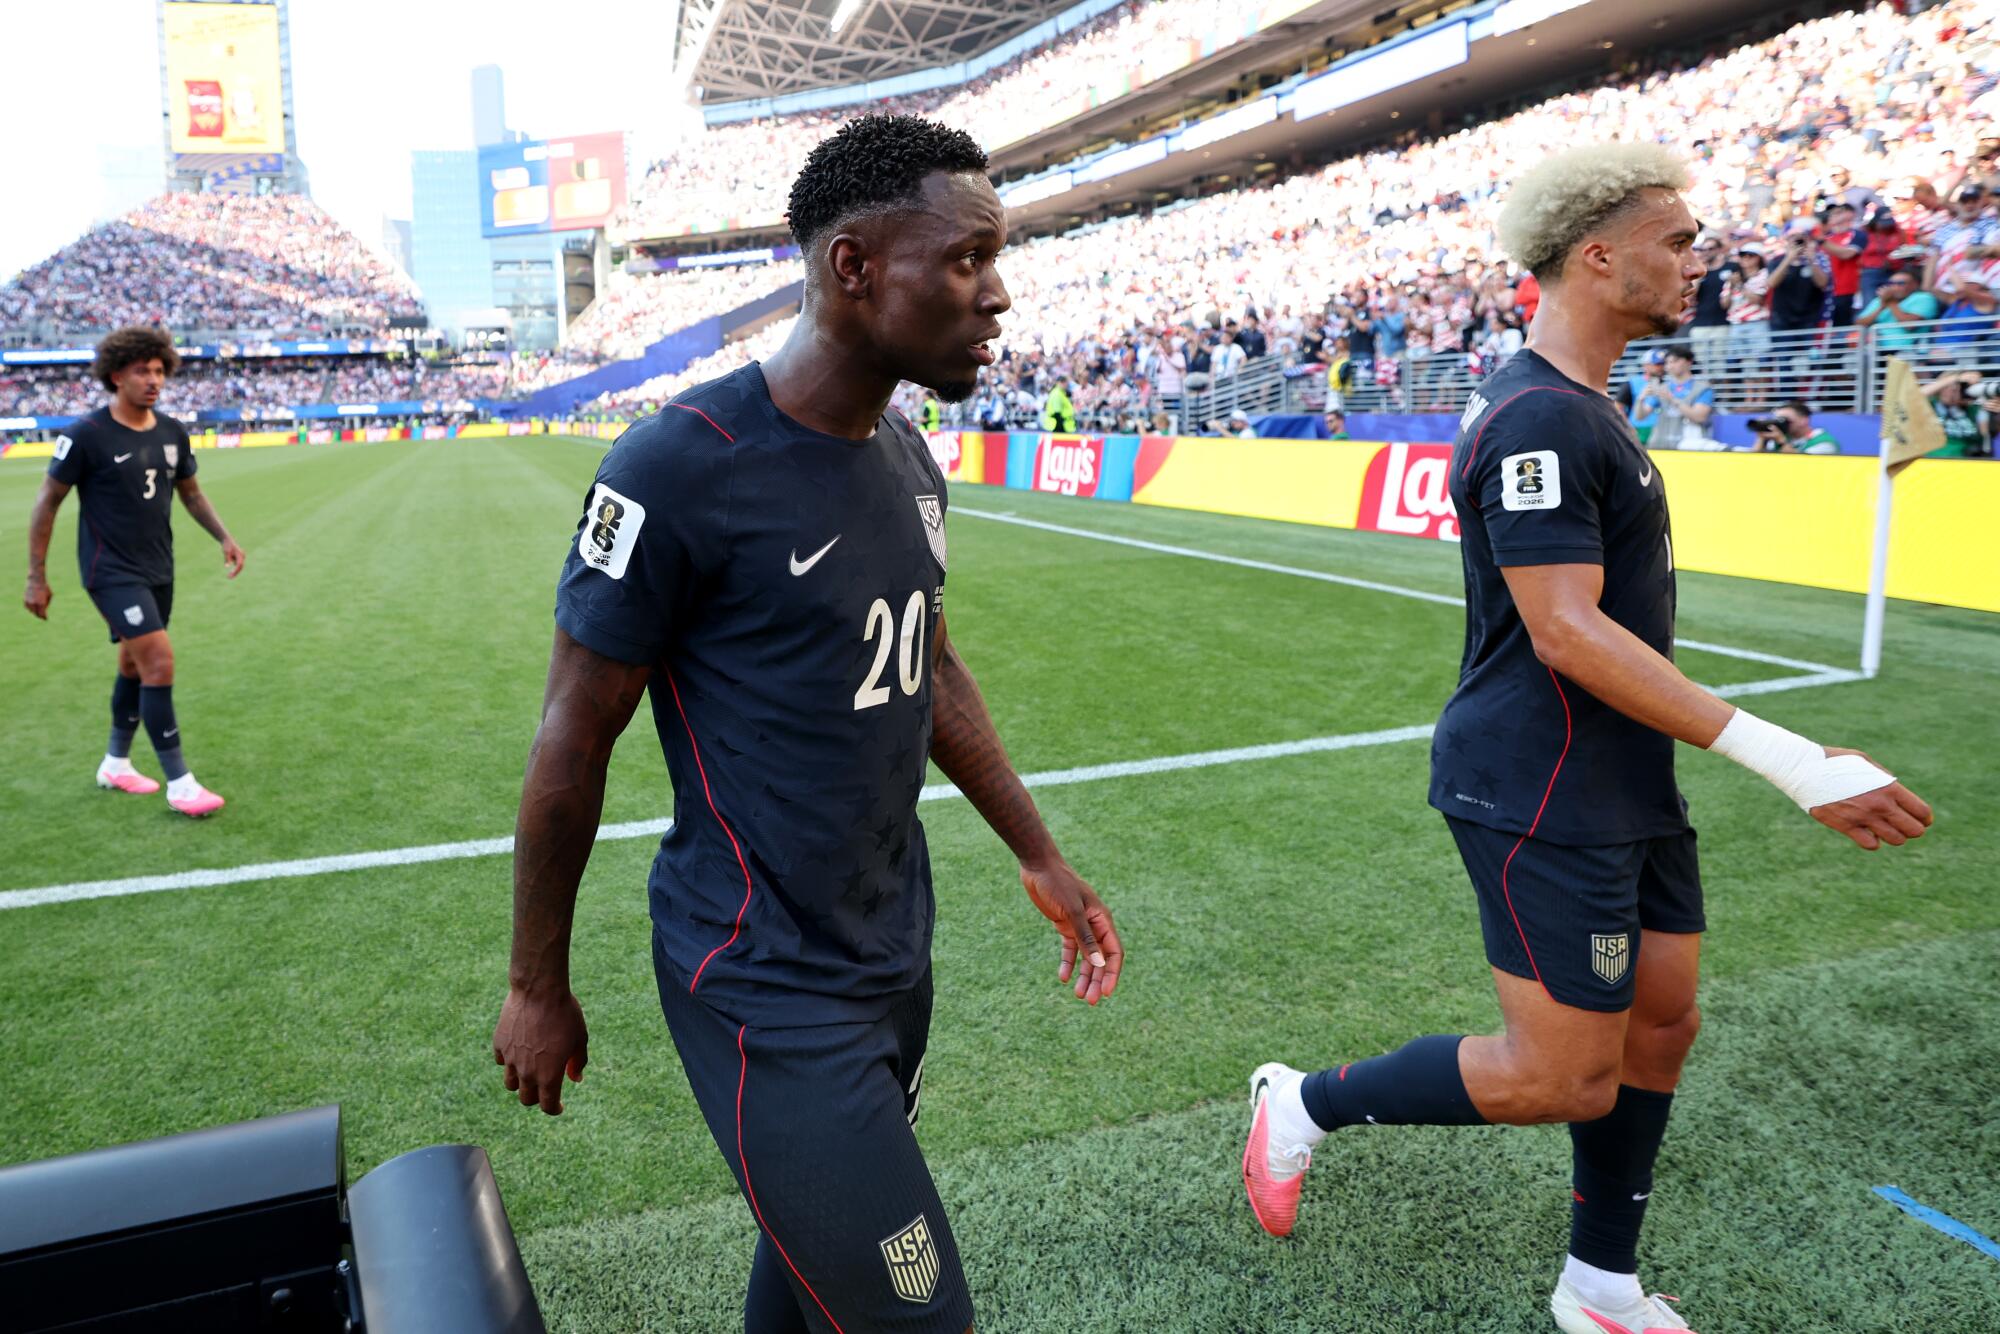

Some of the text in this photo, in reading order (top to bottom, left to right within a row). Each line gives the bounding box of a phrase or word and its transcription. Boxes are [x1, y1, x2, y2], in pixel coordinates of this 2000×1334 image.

[1039, 432, 1096, 496] Lay's
[143, 468, 158, 499] 3
[919, 500, 942, 528] USA
[853, 589, 926, 711] 20
[1595, 937, 1627, 957] USA
[886, 1221, 927, 1263] USA
